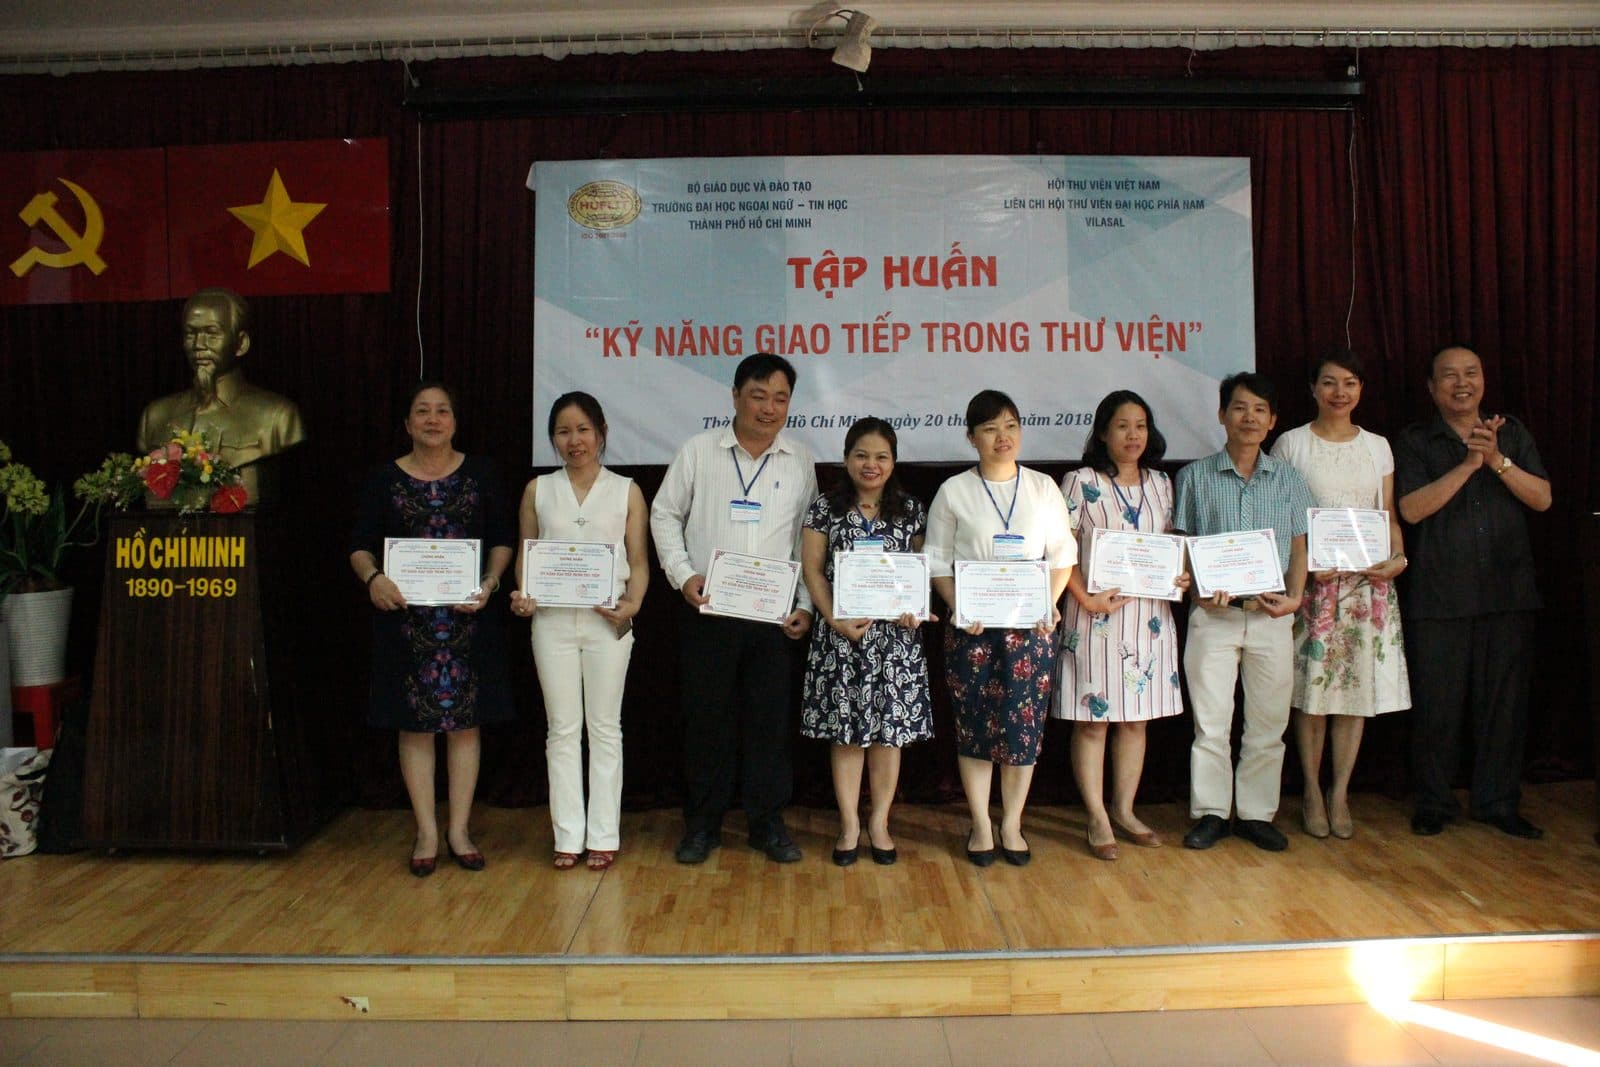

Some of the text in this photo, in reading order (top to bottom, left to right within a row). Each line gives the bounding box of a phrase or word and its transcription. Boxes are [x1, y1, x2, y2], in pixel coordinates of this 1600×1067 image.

[687, 180, 812, 196] BỘ GIÁO DỤC VÀ ĐÀO TẠO
[1047, 178, 1065, 192] HỘI
[1114, 178, 1136, 192] VIỆT
[1138, 180, 1160, 190] NAM
[652, 200, 693, 213] TRƯỜNG
[696, 201, 713, 214] ĐẠI
[715, 200, 736, 214] HỌC
[738, 200, 769, 213] NGOẠI
[772, 198, 794, 211] NGỮ
[808, 200, 824, 210] TIN
[827, 200, 848, 212] HỌC
[1004, 197, 1026, 209] LIÊN
[1028, 199, 1045, 209] CHI
[1048, 197, 1065, 212] HỘI
[1115, 199, 1132, 212] ĐẠI
[1134, 199, 1155, 212] HỌC
[1157, 197, 1180, 210] PHÍA
[1182, 199, 1205, 210] NAM
[688, 218, 722, 230] THÀNH
[725, 216, 746, 230] PHỐ
[765, 217, 783, 229] CHÍ
[785, 218, 812, 229] MINH
[1085, 217, 1125, 228] VILASAL
[787, 241, 998, 299] TẬP HUẤN
[655, 319, 744, 357] NĂNG
[754, 322, 831, 356] GIAO
[841, 310, 911, 354] TIẾP
[921, 321, 1030, 353] TRONG
[1040, 316, 1106, 353] THƯ
[787, 414, 807, 429] Hồ
[811, 414, 836, 429] Chí
[886, 416, 921, 431] ngày
[924, 415, 943, 427] 20
[1020, 415, 1050, 426] năm
[1054, 414, 1093, 426] 2018
[116, 527, 246, 569] HỒ CHÍ MINH
